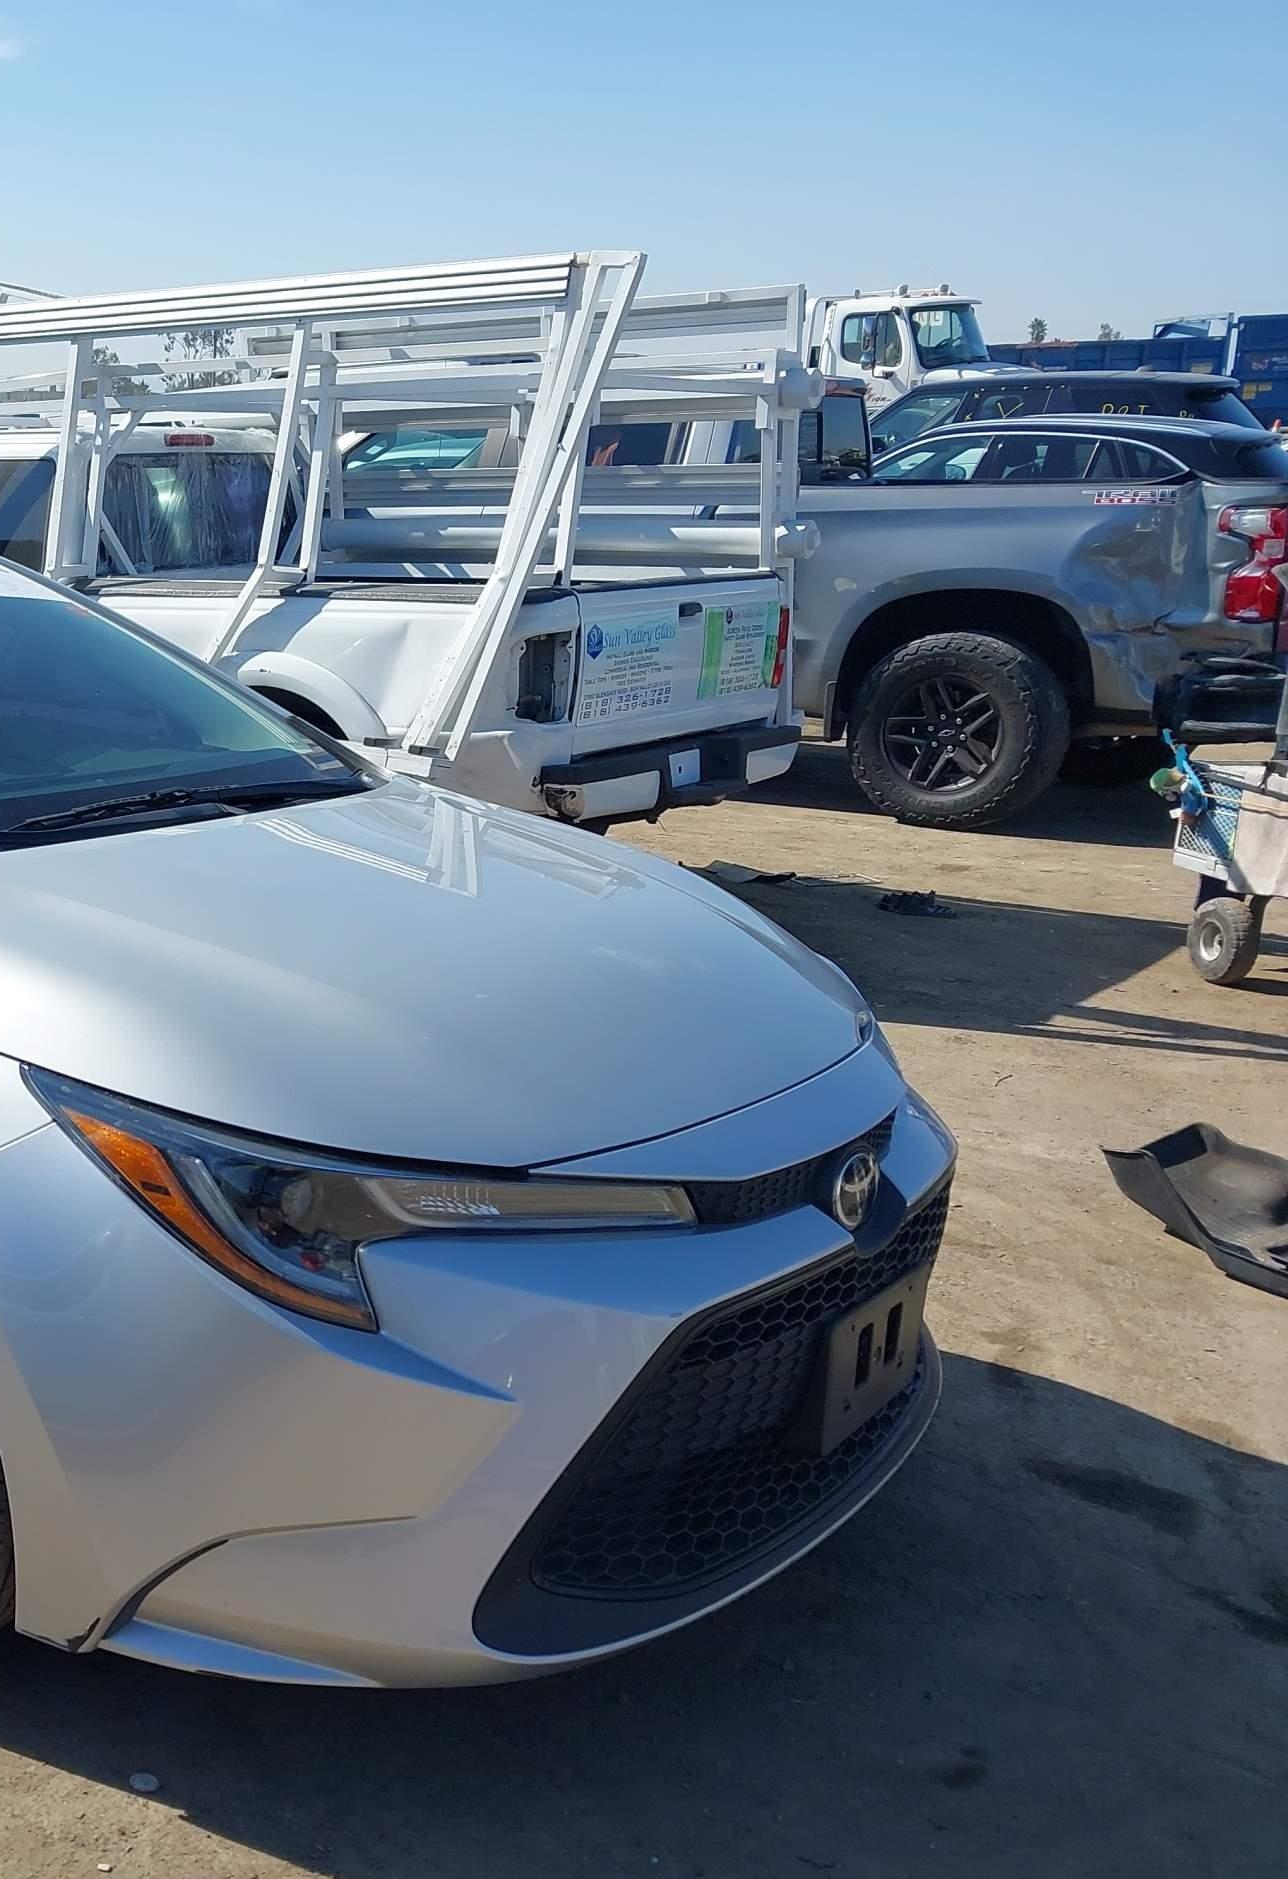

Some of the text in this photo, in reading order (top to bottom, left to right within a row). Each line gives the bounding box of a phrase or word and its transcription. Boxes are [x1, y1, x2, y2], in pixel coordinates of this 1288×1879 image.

[1094, 497, 1177, 505] BOSS
[603, 622, 676, 649] Sun Valley Glass
[579, 706, 611, 721] (818)
[615, 695, 670, 712] 439-6362
[580, 697, 612, 712] (818)
[616, 686, 672, 704] 326-1728
